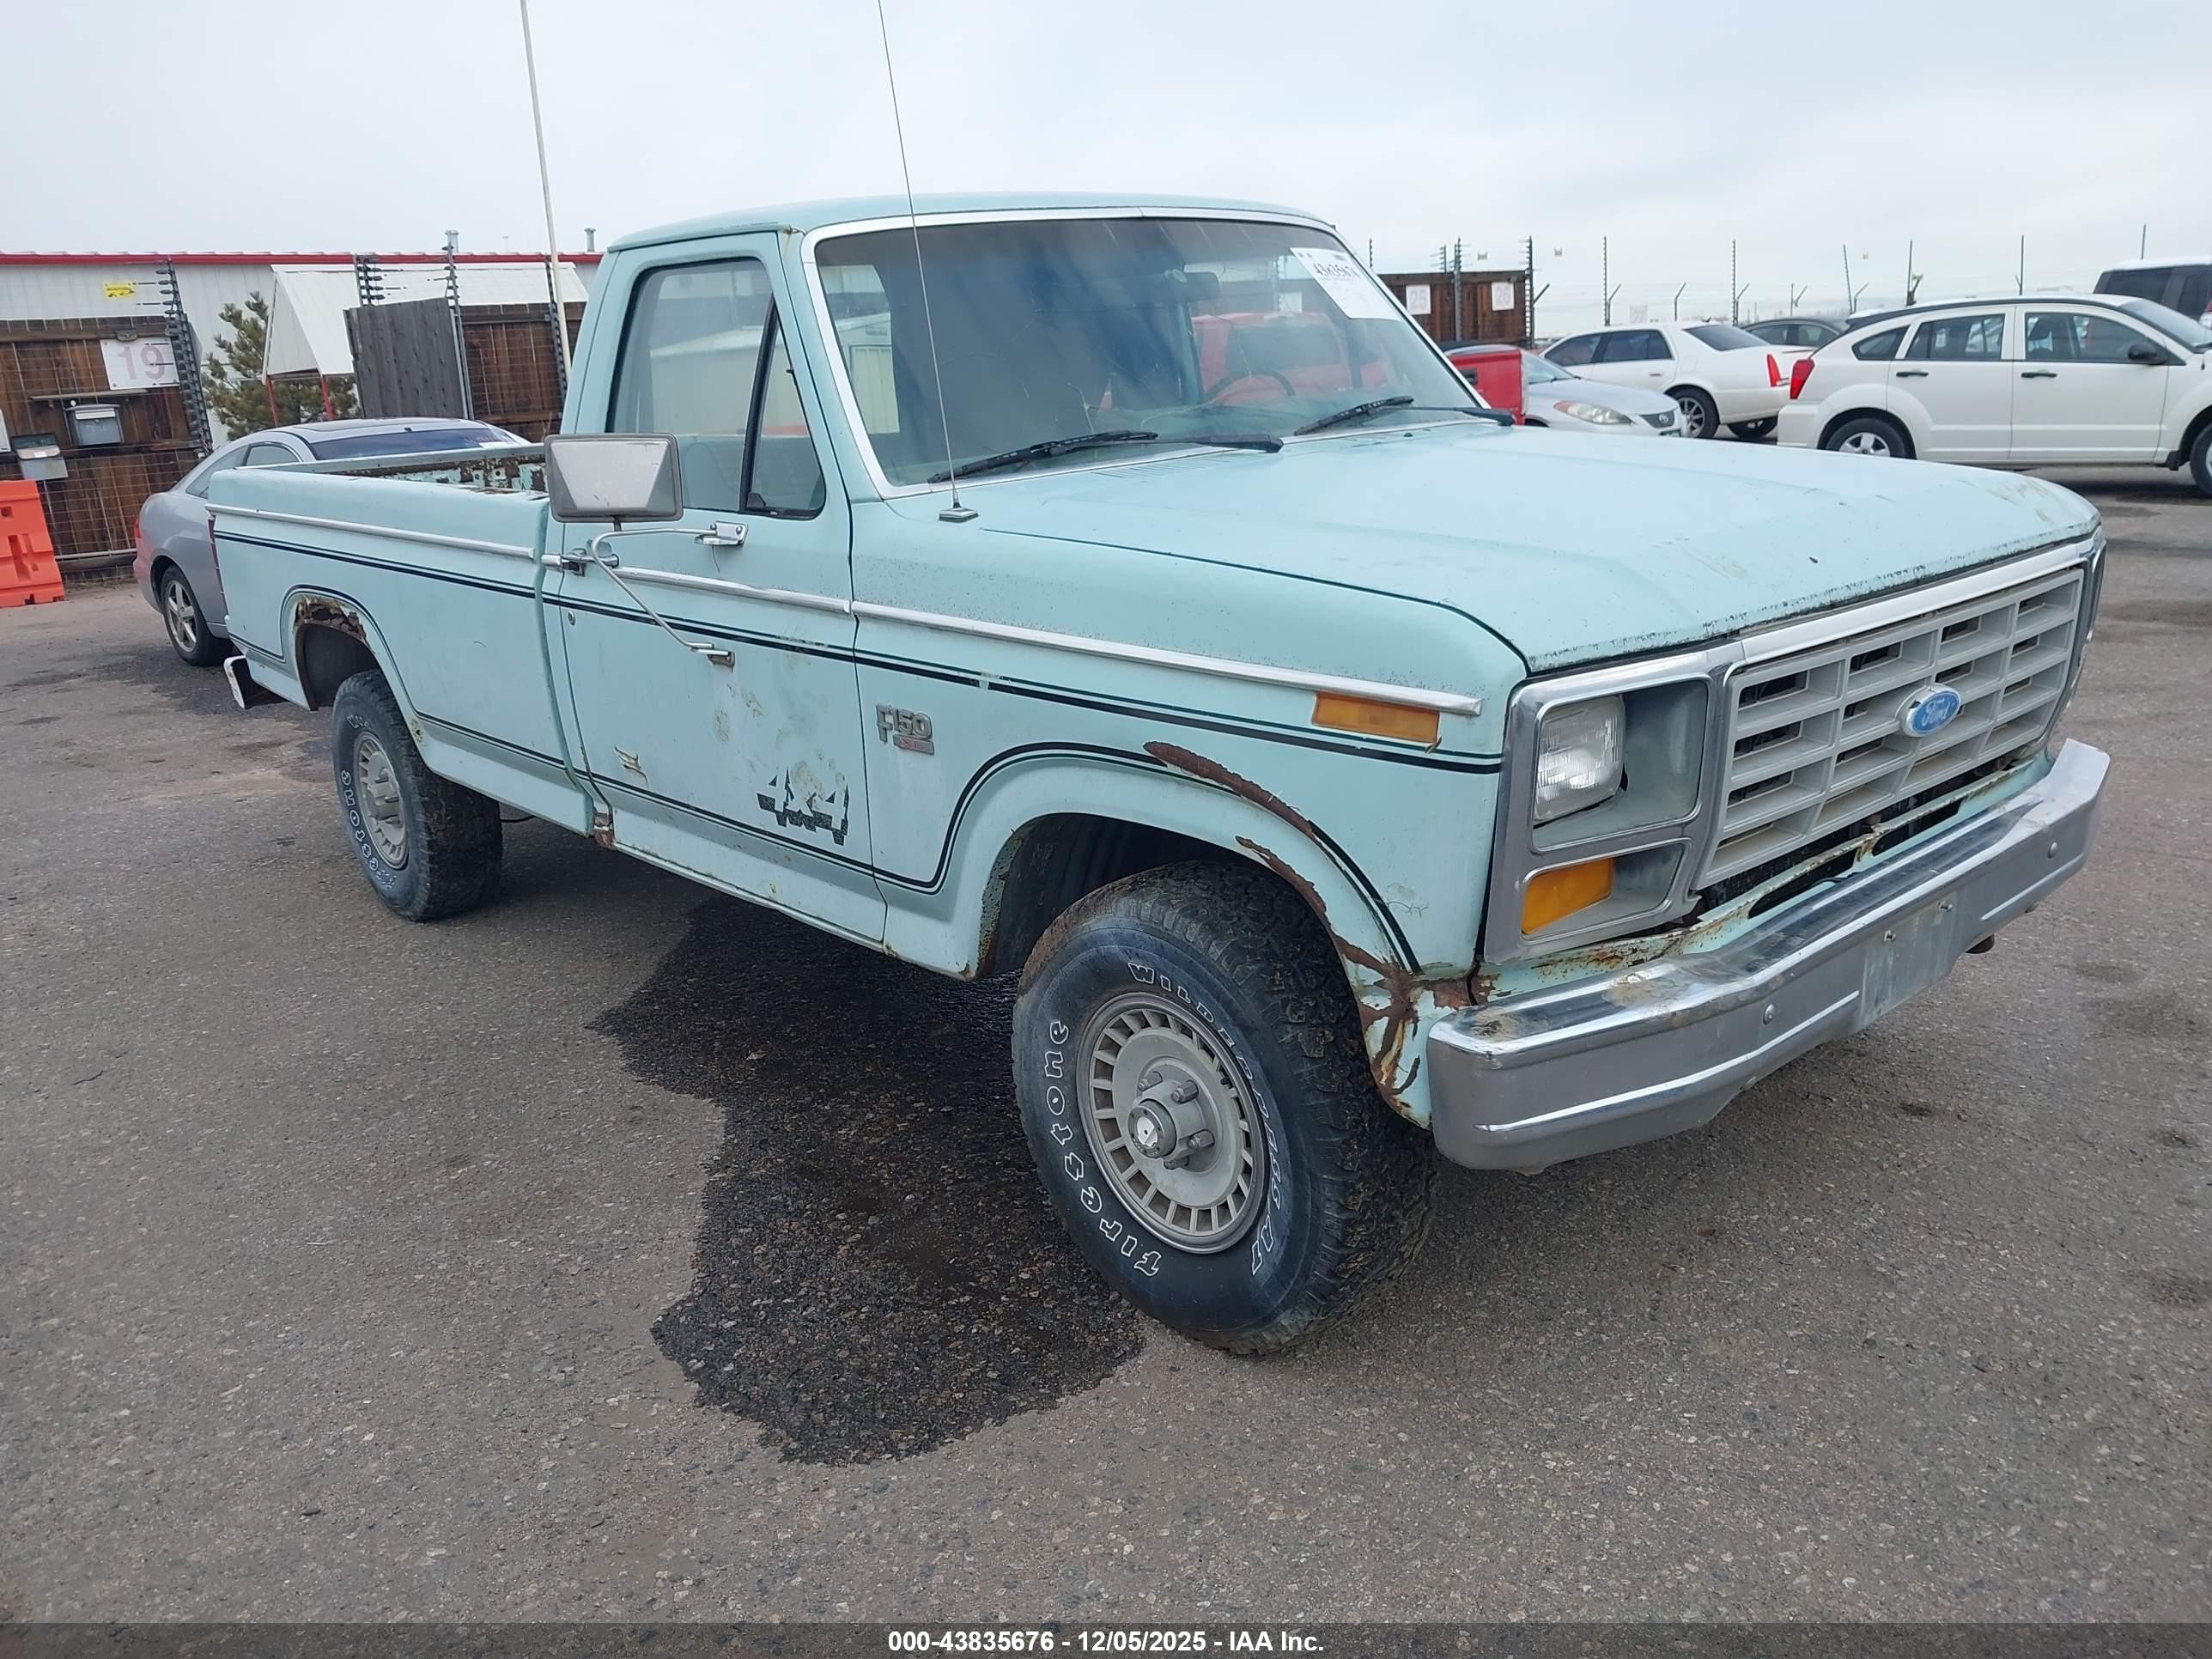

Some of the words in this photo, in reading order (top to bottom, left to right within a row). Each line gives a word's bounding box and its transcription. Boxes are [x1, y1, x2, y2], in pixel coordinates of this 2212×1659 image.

[1409, 289, 1427, 310] 25
[1496, 286, 1511, 305] 26
[118, 345, 166, 380] 19
[1920, 697, 1956, 727] Ford
[1127, 961, 1281, 1211] WILDERNESS
[1043, 1019, 1162, 1277] Firestone
